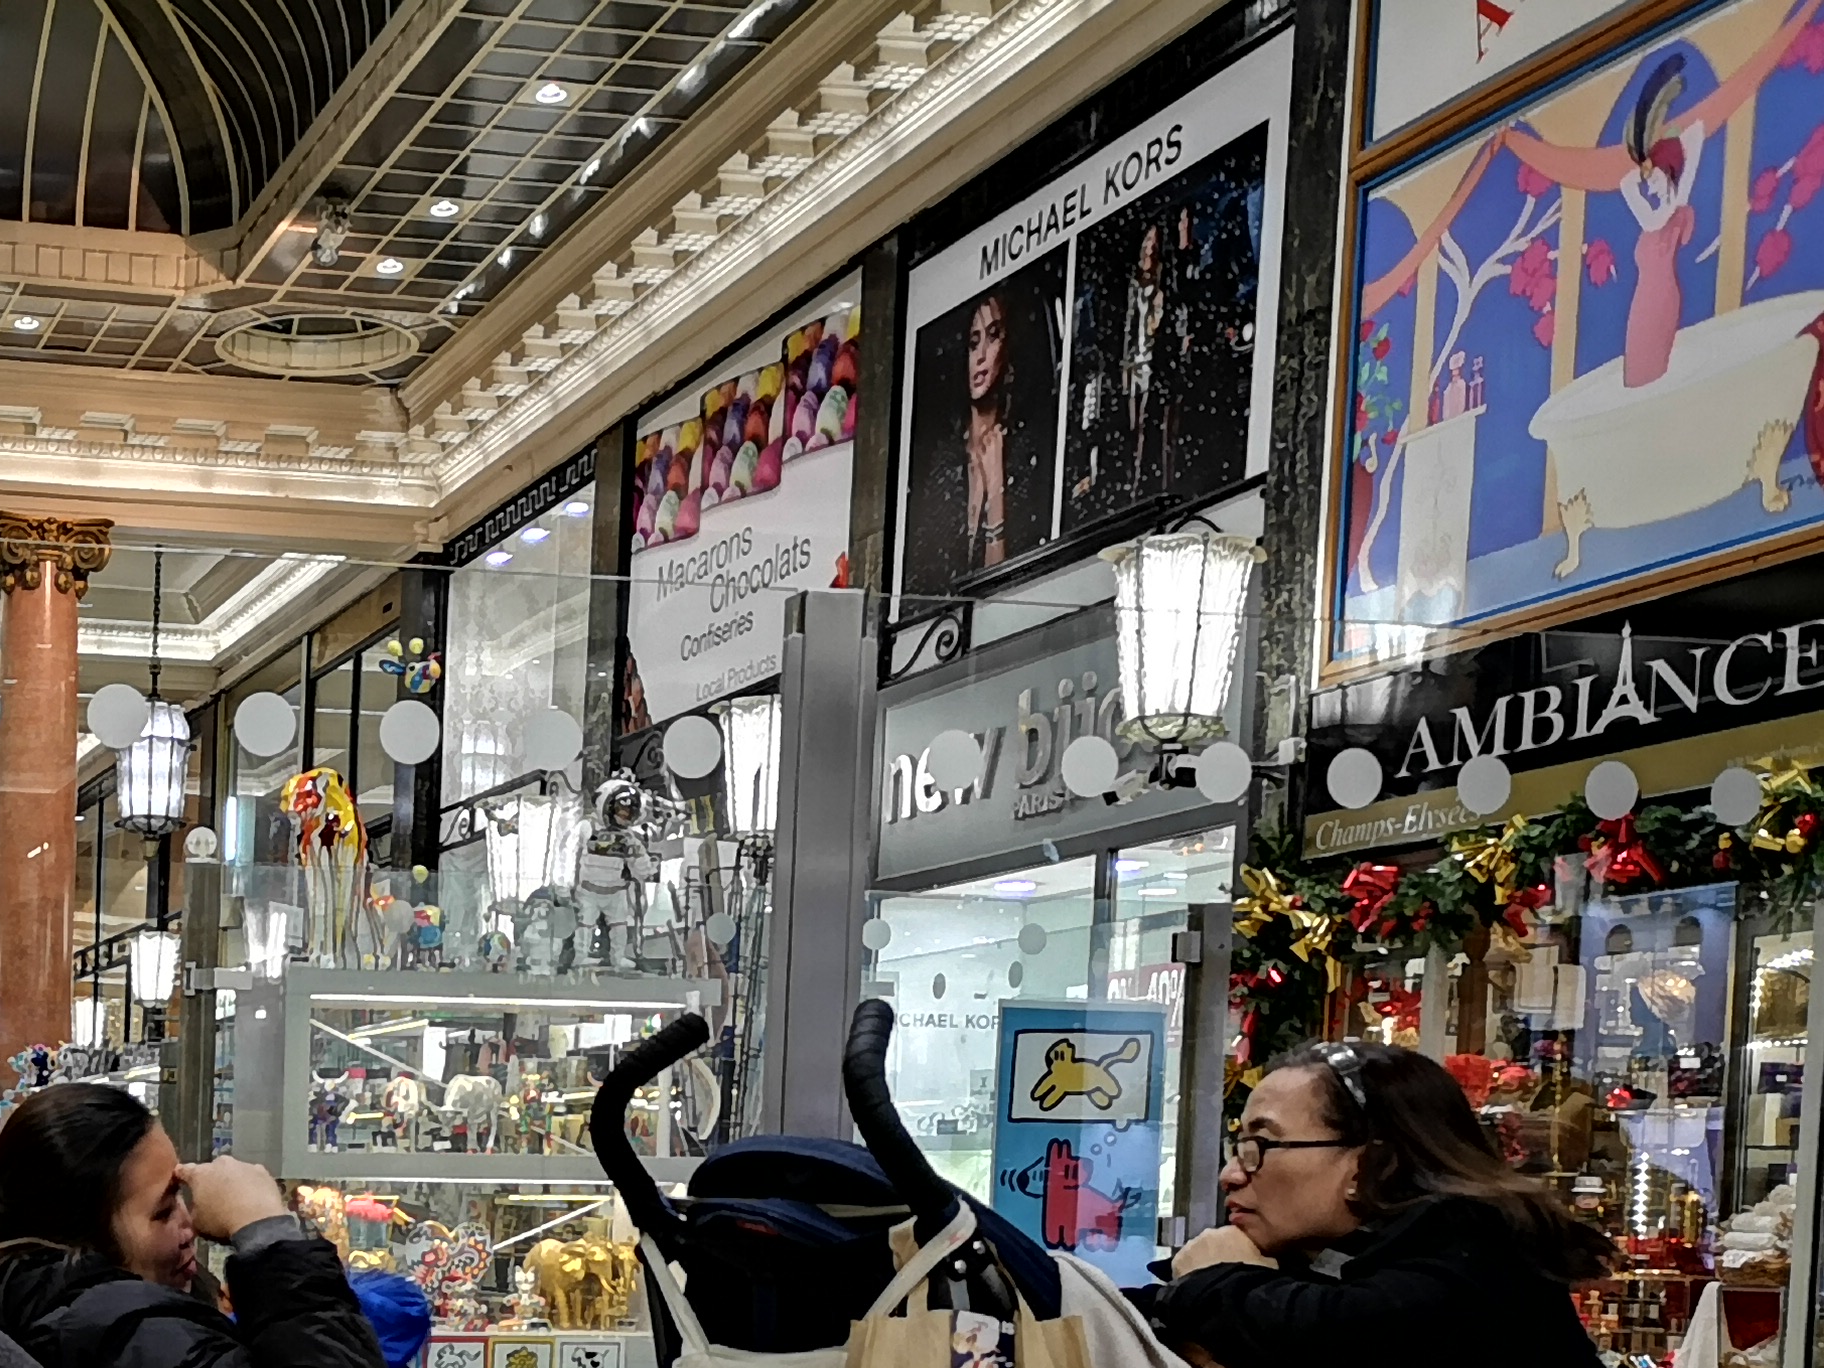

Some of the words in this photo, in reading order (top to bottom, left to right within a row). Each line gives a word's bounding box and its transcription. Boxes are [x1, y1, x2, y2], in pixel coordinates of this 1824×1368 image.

[979, 183, 1092, 280] MICHAEL
[1103, 124, 1183, 205] KORS
[657, 526, 753, 602] Macarons
[710, 536, 812, 613] Chocolats
[681, 611, 754, 661] Confiseries
[696, 672, 726, 702] Local
[728, 654, 777, 686] Products
